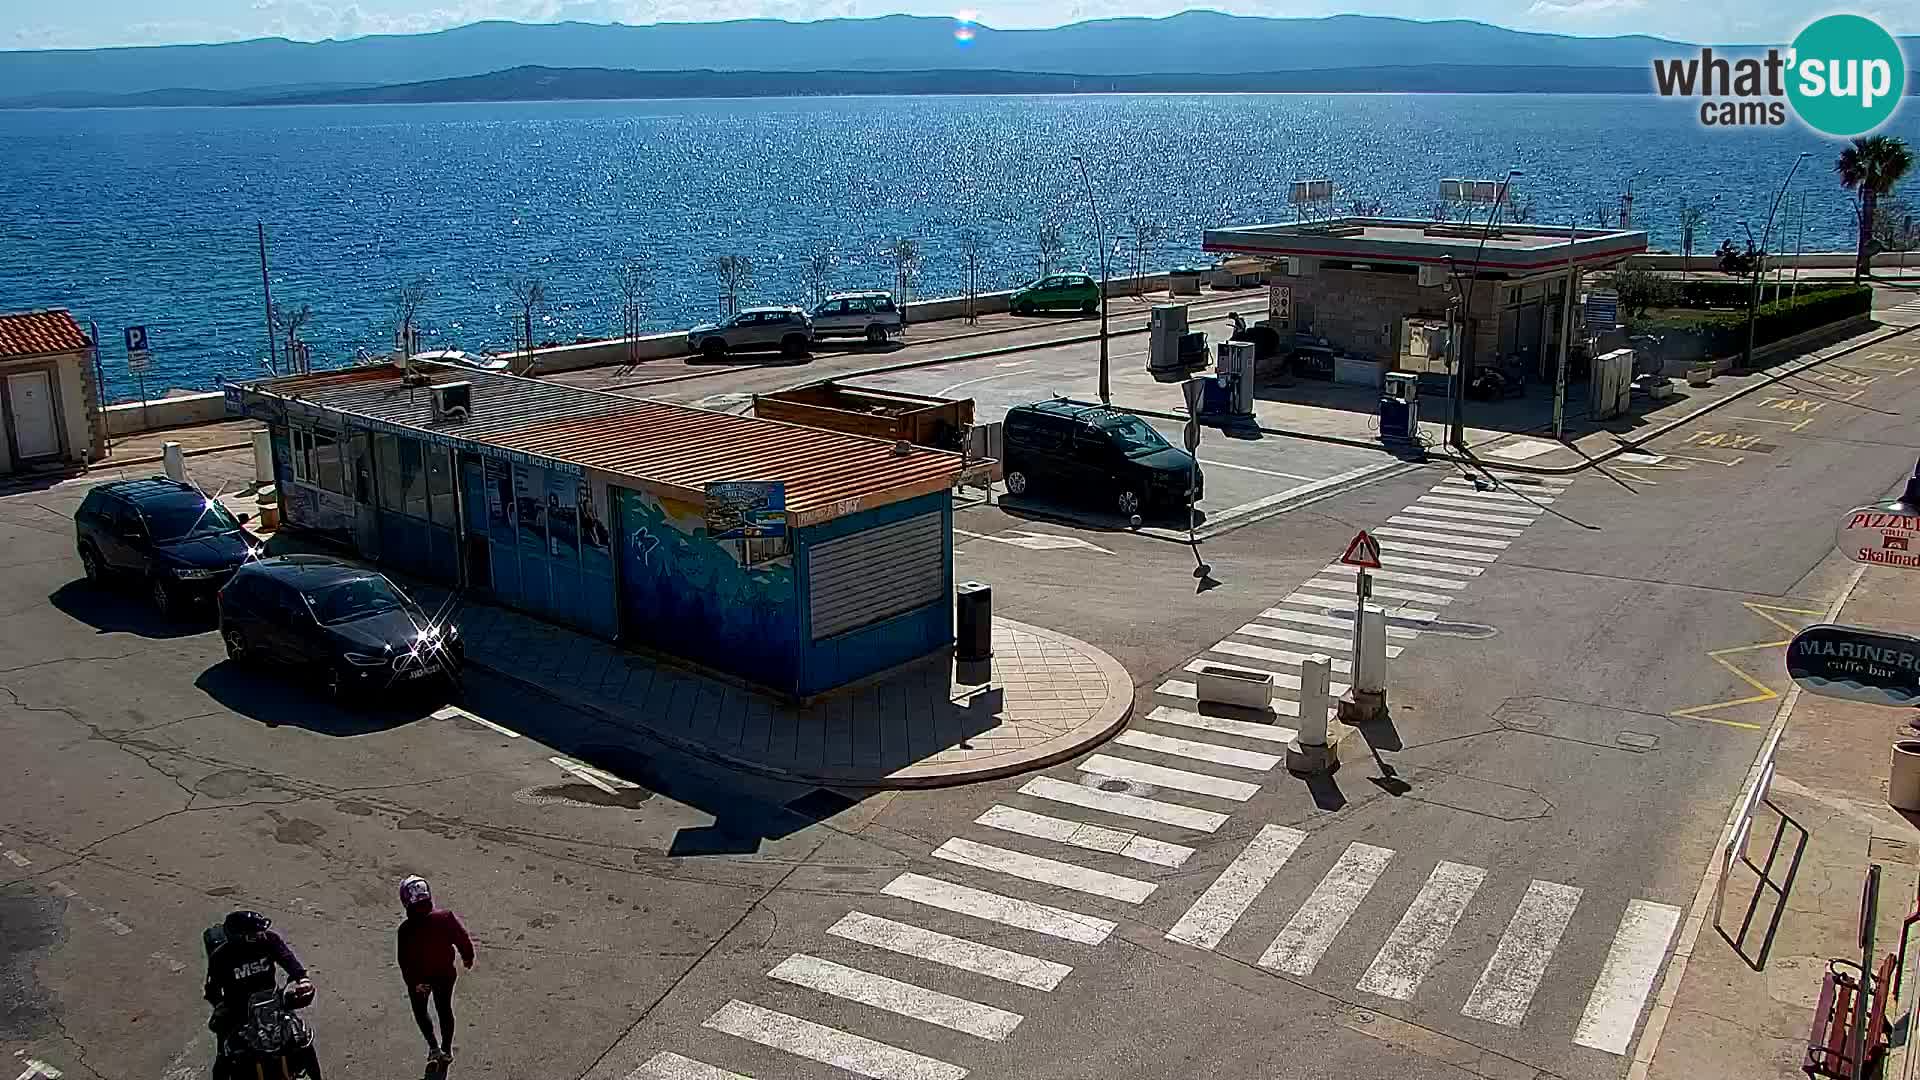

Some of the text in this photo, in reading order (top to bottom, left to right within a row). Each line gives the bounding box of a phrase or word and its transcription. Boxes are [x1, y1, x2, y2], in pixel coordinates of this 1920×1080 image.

[128, 328, 141, 348] P
[1757, 397, 1827, 412] TAXI
[1684, 430, 1762, 450] TAXI
[493, 448, 525, 465] STATION
[527, 454, 554, 469] TICKET
[554, 460, 582, 476] OFFICE
[1868, 664, 1896, 679] bar
